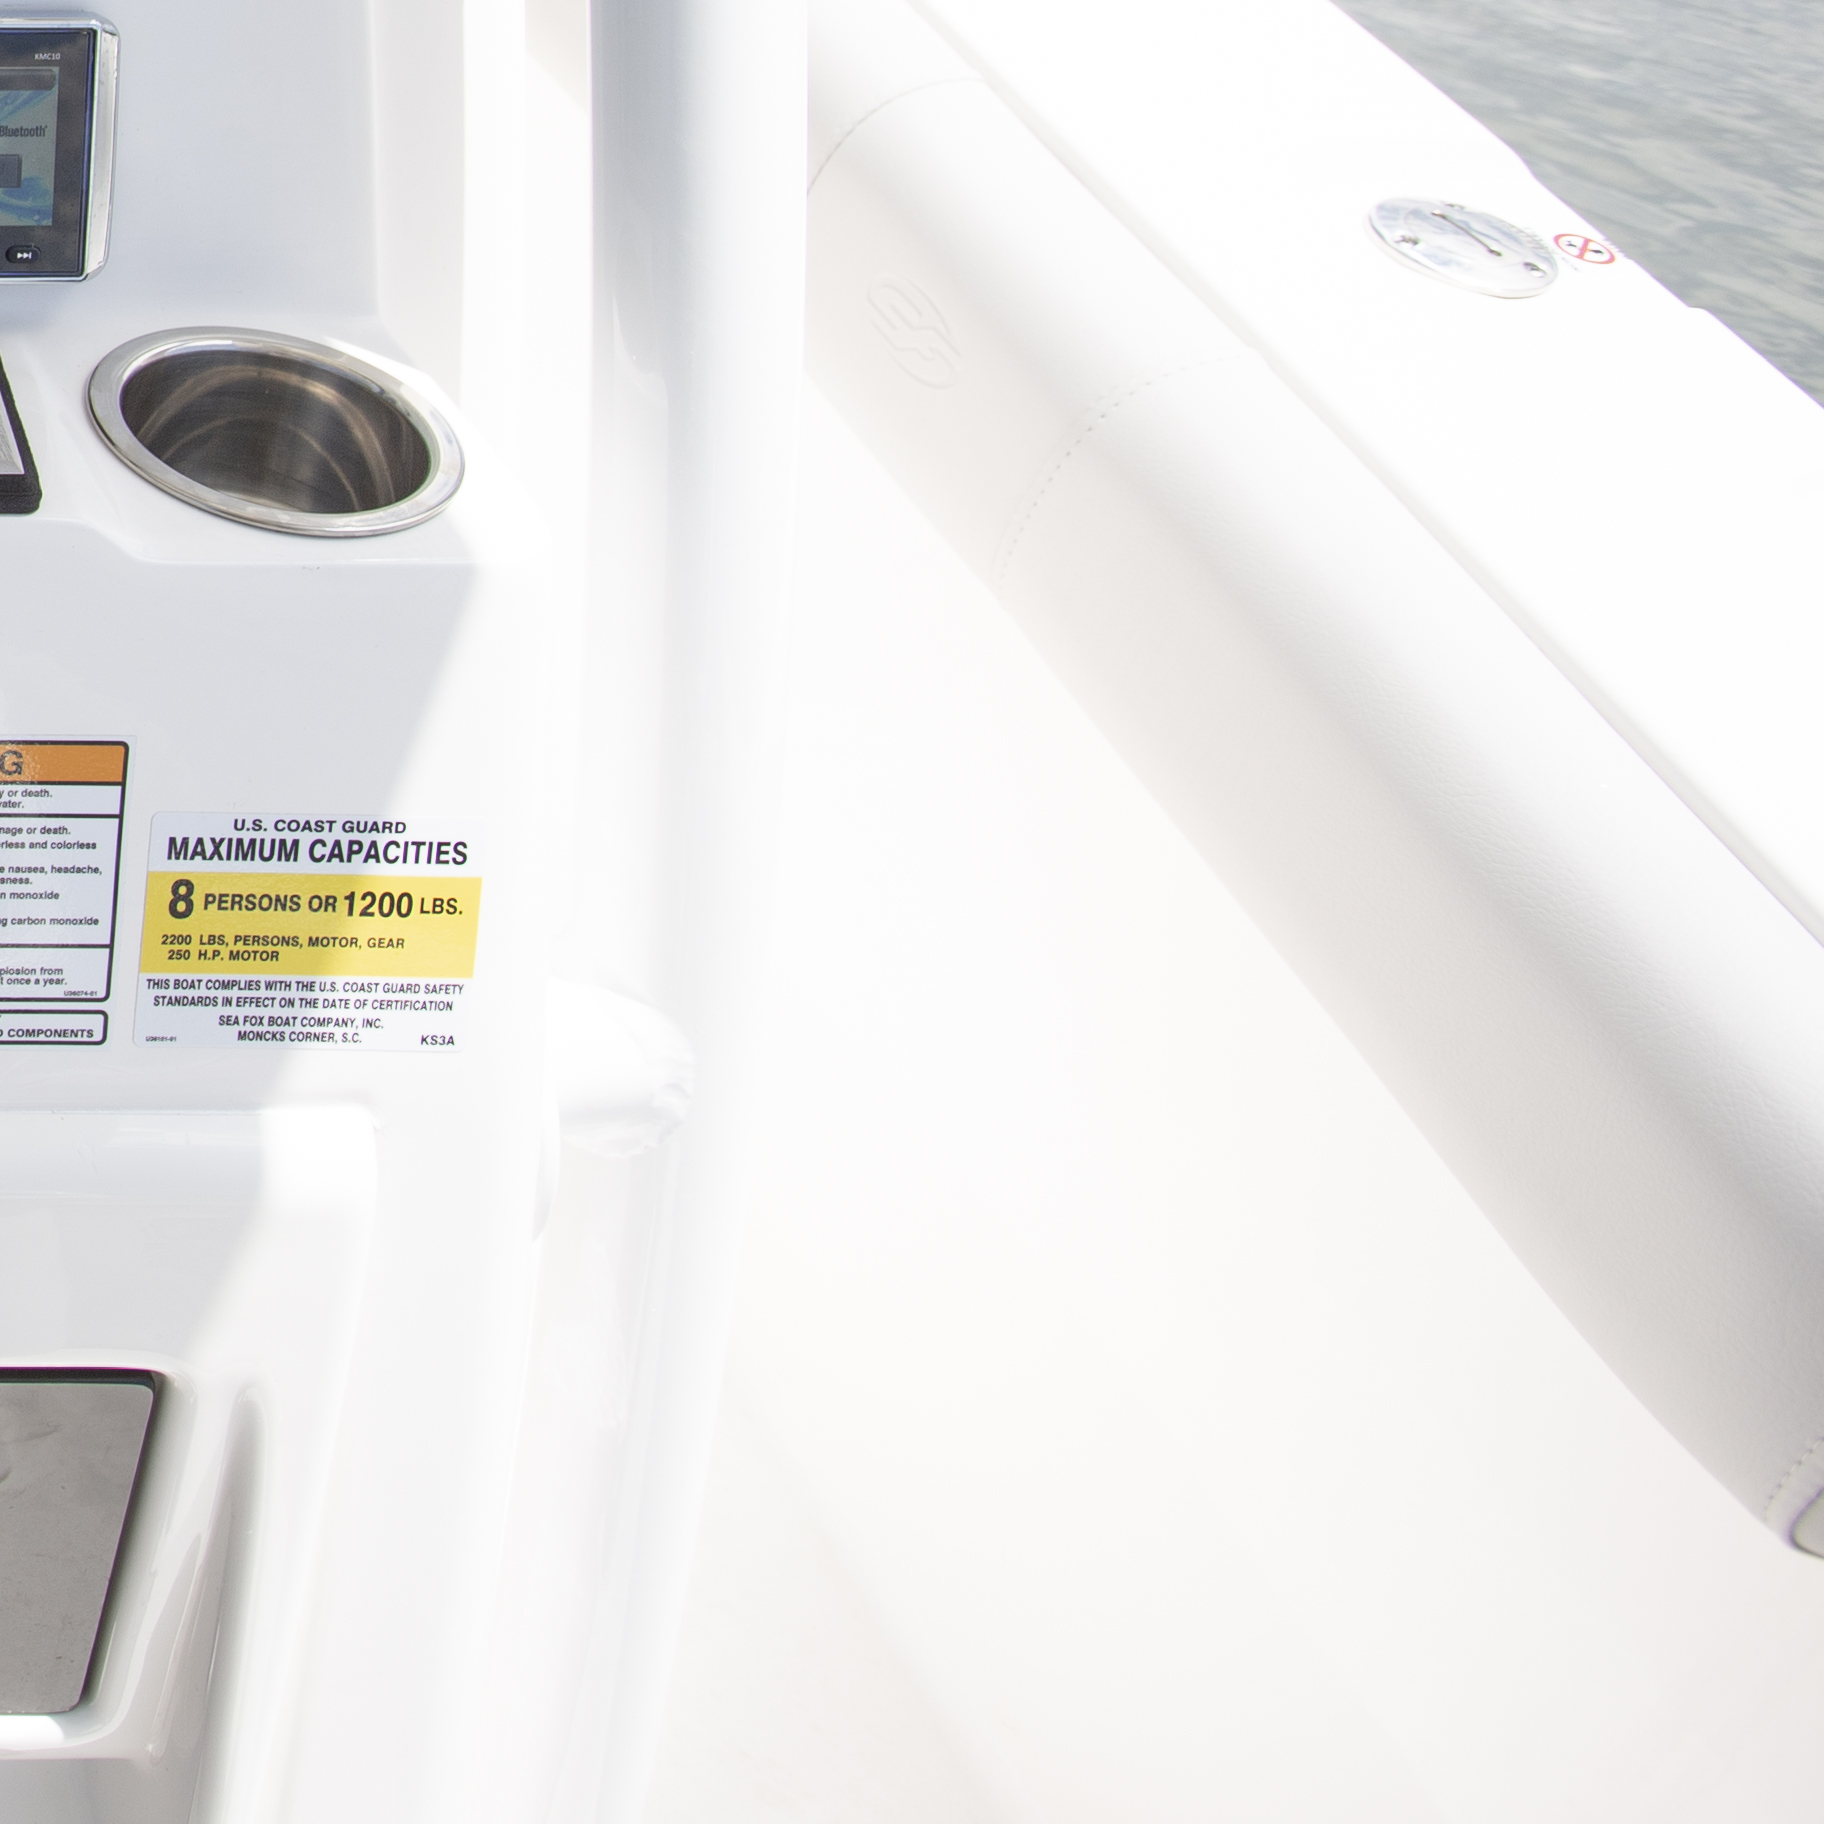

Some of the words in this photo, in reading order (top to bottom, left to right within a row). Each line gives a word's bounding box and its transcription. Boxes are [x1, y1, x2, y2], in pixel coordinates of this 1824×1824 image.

[33, 52, 61, 60] KMC10
[6, 789, 18, 797] or
[20, 788, 52, 797] death.
[233, 818, 268, 832] U.S.
[273, 818, 337, 833] COAST
[341, 819, 407, 834] GUARD
[166, 836, 300, 862] MAXIMUM
[308, 838, 468, 865] CAPACITIES
[167, 878, 195, 919] 8
[203, 892, 301, 912] PERSONS
[307, 894, 338, 912] OR
[342, 890, 413, 918] 1200
[419, 896, 463, 915] LBS.
[160, 933, 192, 945] 2200
[198, 933, 229, 947] LBS,
[232, 934, 303, 948] PERSONS,
[306, 935, 362, 949] MOTOR,
[366, 936, 405, 948] GEAR
[167, 948, 191, 960] 250
[197, 948, 224, 961] H.P.
[228, 949, 280, 962] MOTOR
[145, 978, 170, 990] THIS
[172, 978, 203, 990] BOAT
[204, 978, 261, 991] COMPLIES
[263, 979, 292, 991] WITH
[294, 980, 316, 992] THE
[318, 980, 339, 992] U.S.
[342, 981, 380, 993] COAST
[382, 982, 421, 994] GUARD
[423, 983, 464, 994] SAFETY
[152, 994, 219, 1007] STANDARDS
[221, 995, 233, 1007] IN
[235, 996, 277, 1008] EFFECT
[278, 996, 296, 1008] ON
[297, 996, 320, 1009] THE
[321, 997, 351, 1009] DATE
[353, 998, 369, 1010] OF
[370, 998, 453, 1011] CERTIFICATION
[218, 1014, 240, 1026] SEA
[242, 1014, 265, 1026] FOX
[266, 1015, 298, 1027] BOAT
[299, 1016, 358, 1028] COMPANY,
[361, 1017, 384, 1028] INC.
[6, 1028, 94, 1038] COMPONENTS
[236, 1029, 286, 1042] MONCKS
[287, 1030, 338, 1042] CORNER,
[340, 1031, 362, 1043] S.C.
[420, 1034, 455, 1046] KS3A
